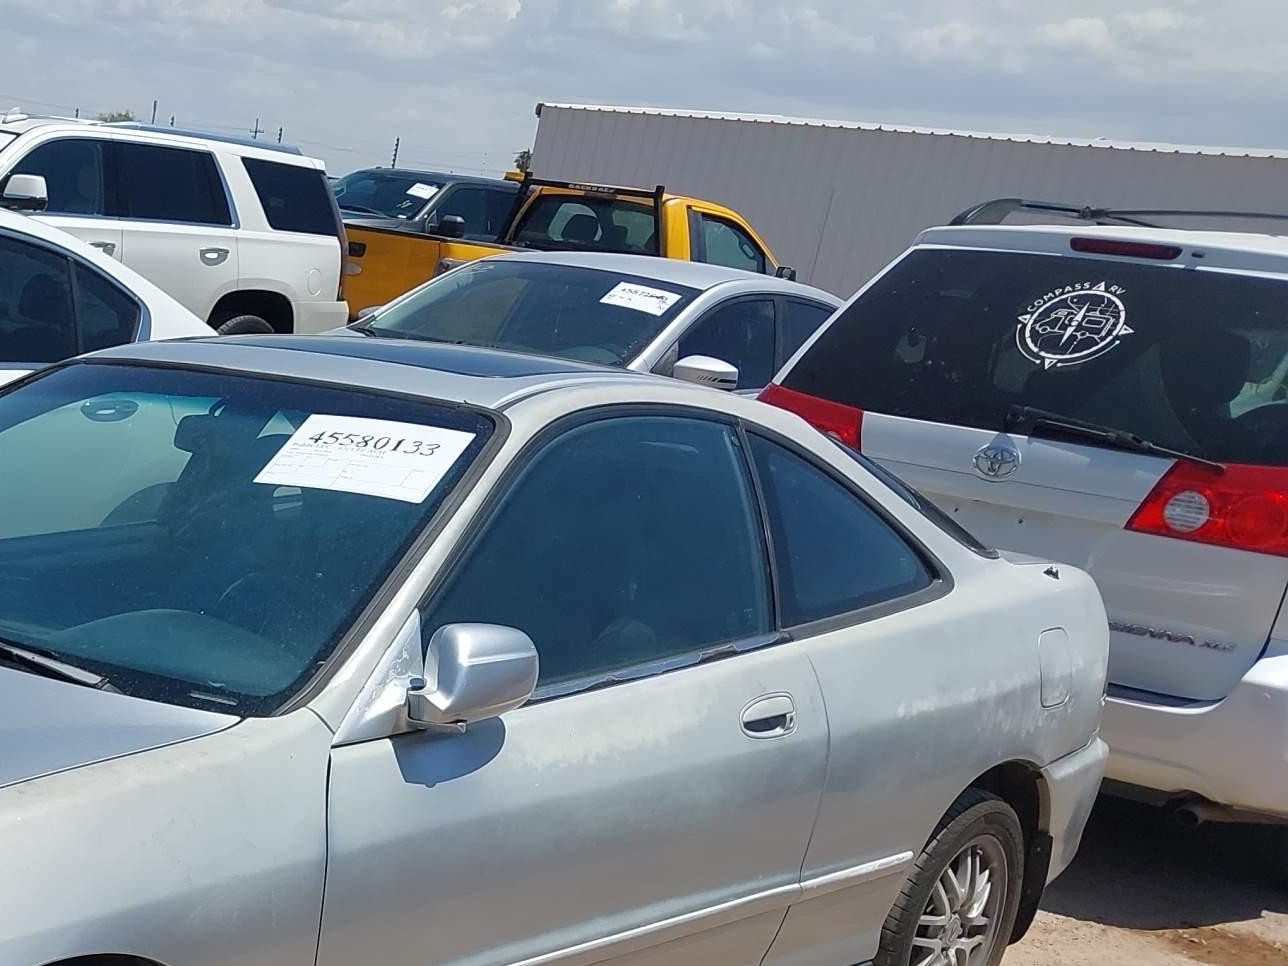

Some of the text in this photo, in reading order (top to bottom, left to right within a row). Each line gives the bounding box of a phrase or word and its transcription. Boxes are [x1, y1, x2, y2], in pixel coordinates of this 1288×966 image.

[1026, 281, 1127, 313] COMPASS RV
[308, 430, 441, 457] 45580133
